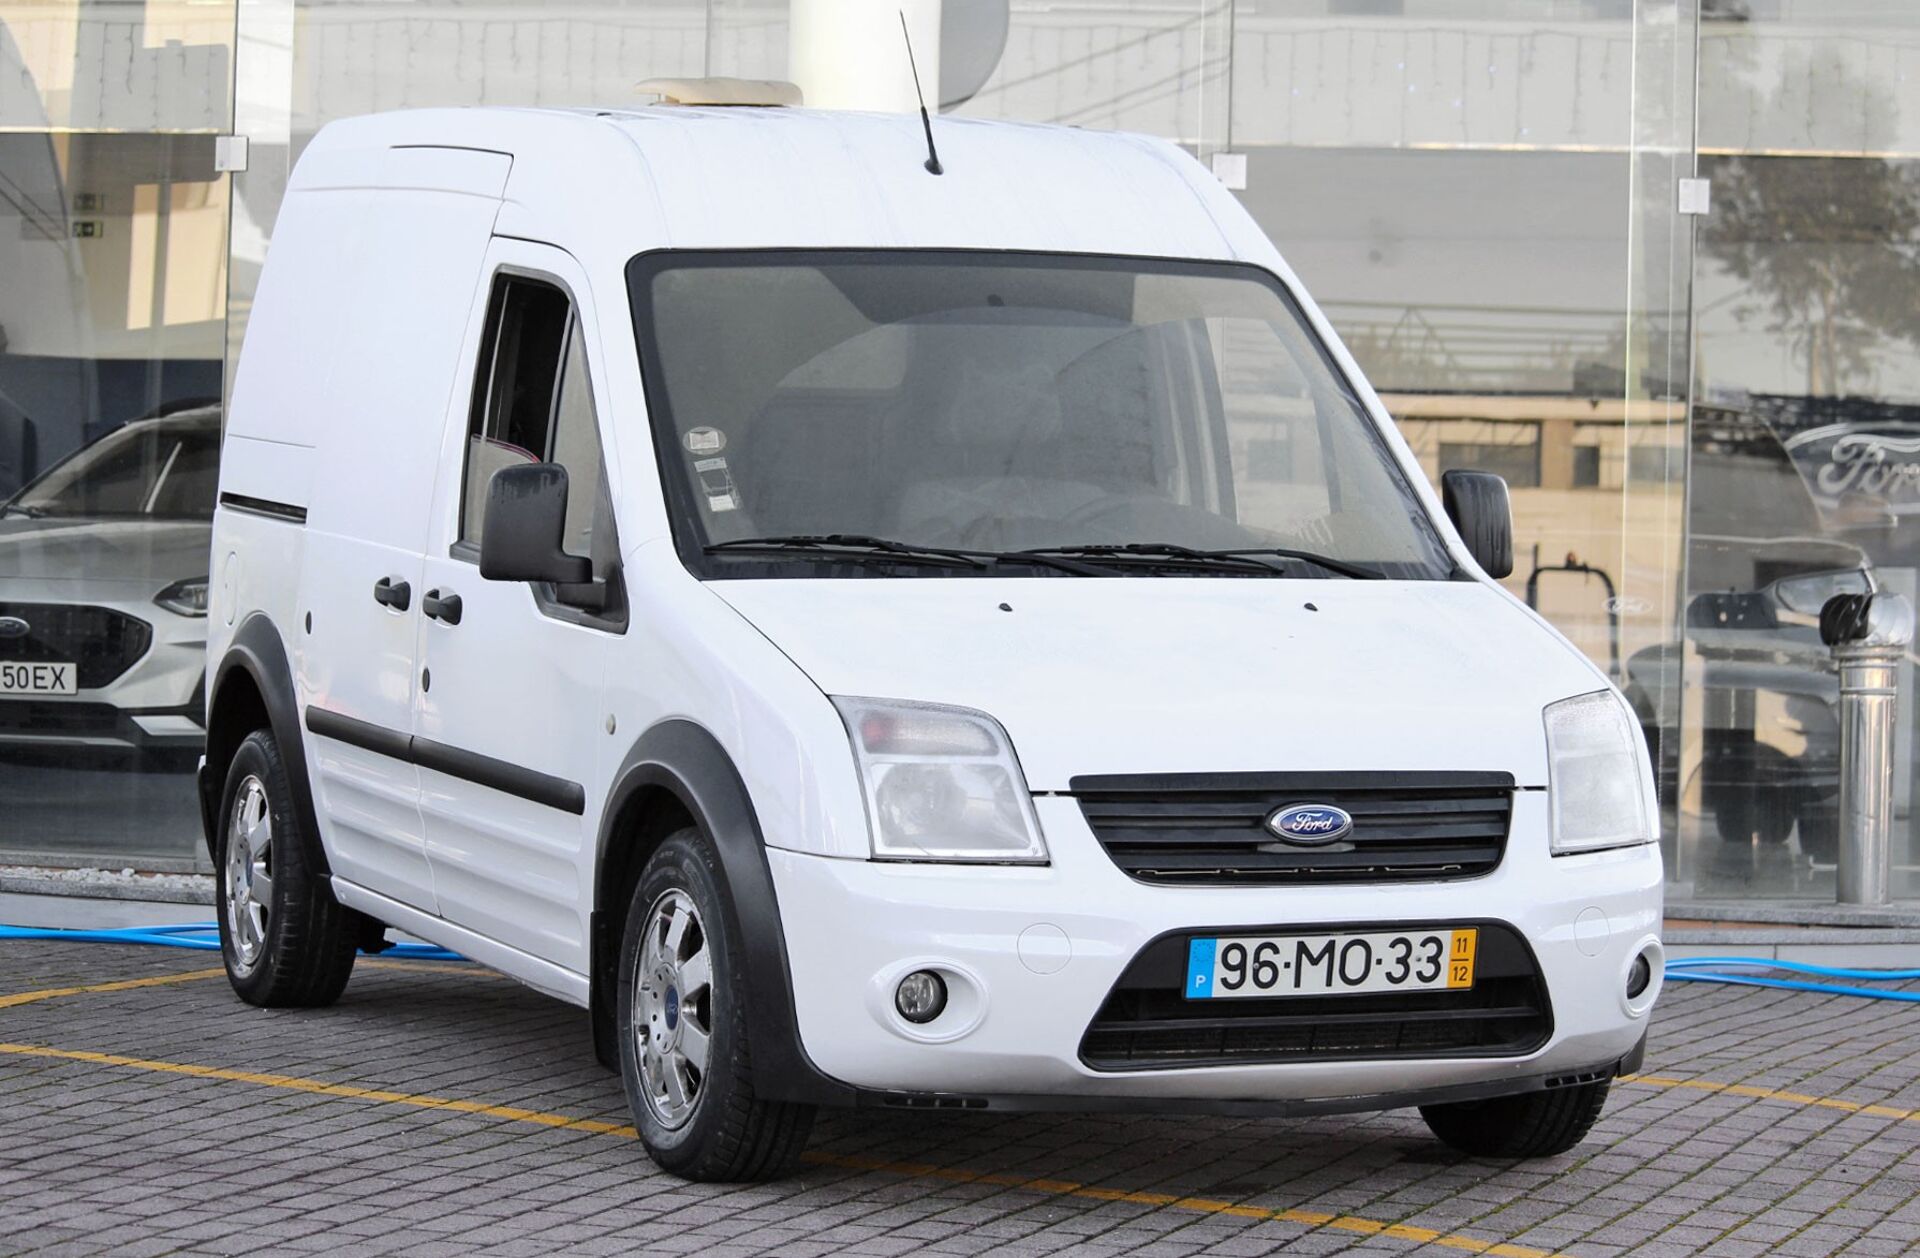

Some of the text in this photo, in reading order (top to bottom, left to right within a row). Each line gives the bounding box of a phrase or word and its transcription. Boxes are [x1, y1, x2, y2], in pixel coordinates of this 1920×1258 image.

[1817, 433, 1920, 494] For
[1291, 812, 1334, 831] Ford
[1455, 937, 1469, 953] 11
[1195, 975, 1206, 988] P
[1452, 965, 1468, 982] 12
